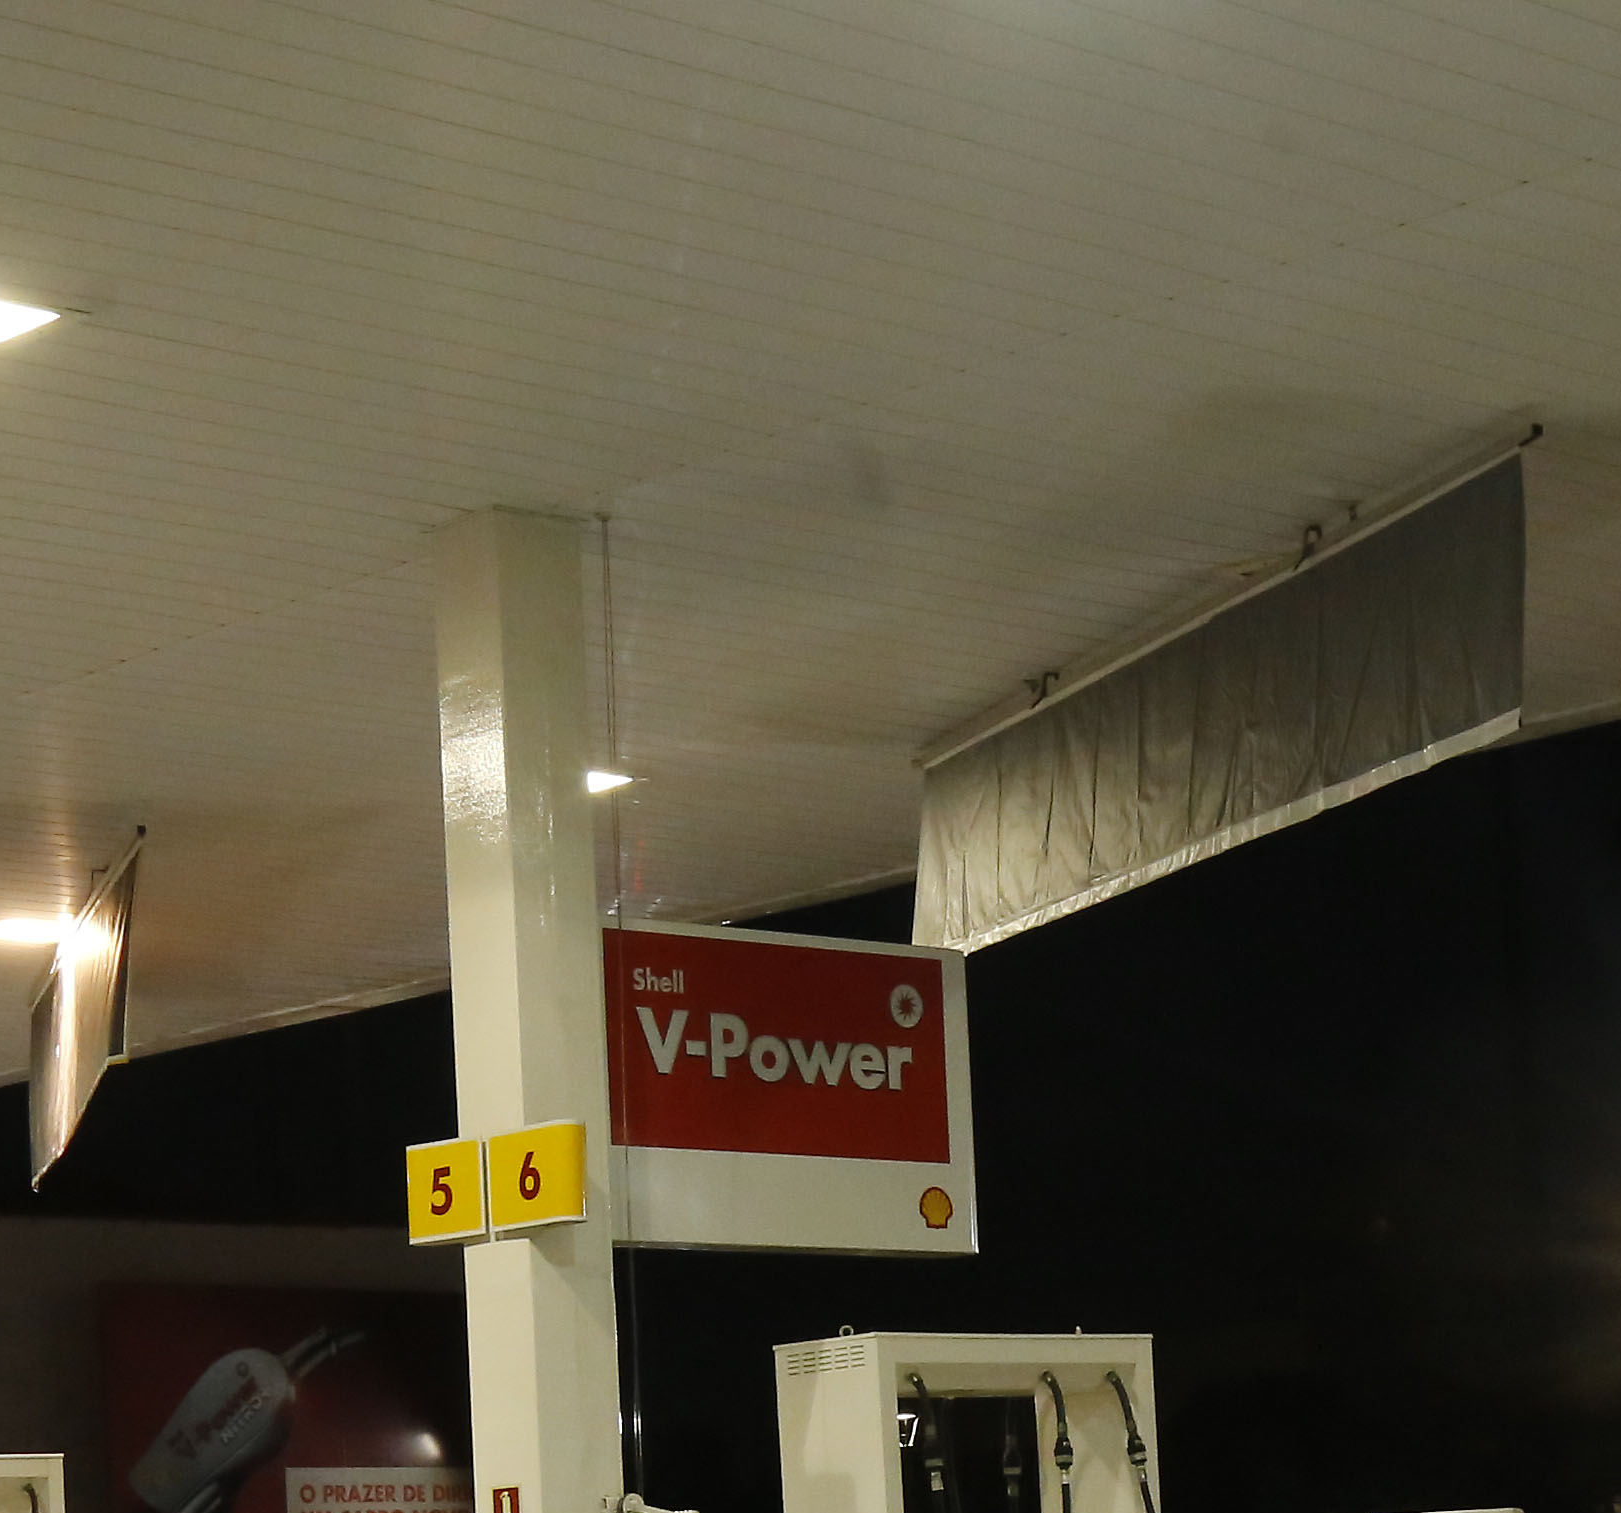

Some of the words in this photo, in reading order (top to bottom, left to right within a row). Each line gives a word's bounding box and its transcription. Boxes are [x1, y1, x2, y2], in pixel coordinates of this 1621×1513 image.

[632, 967, 684, 994] Shell
[635, 1006, 912, 1091] V-Power
[430, 1166, 453, 1216] 5
[518, 1151, 540, 1200] 6
[300, 1484, 316, 1503] O
[324, 1485, 397, 1503] PRAZER
[404, 1485, 426, 1502] DE
